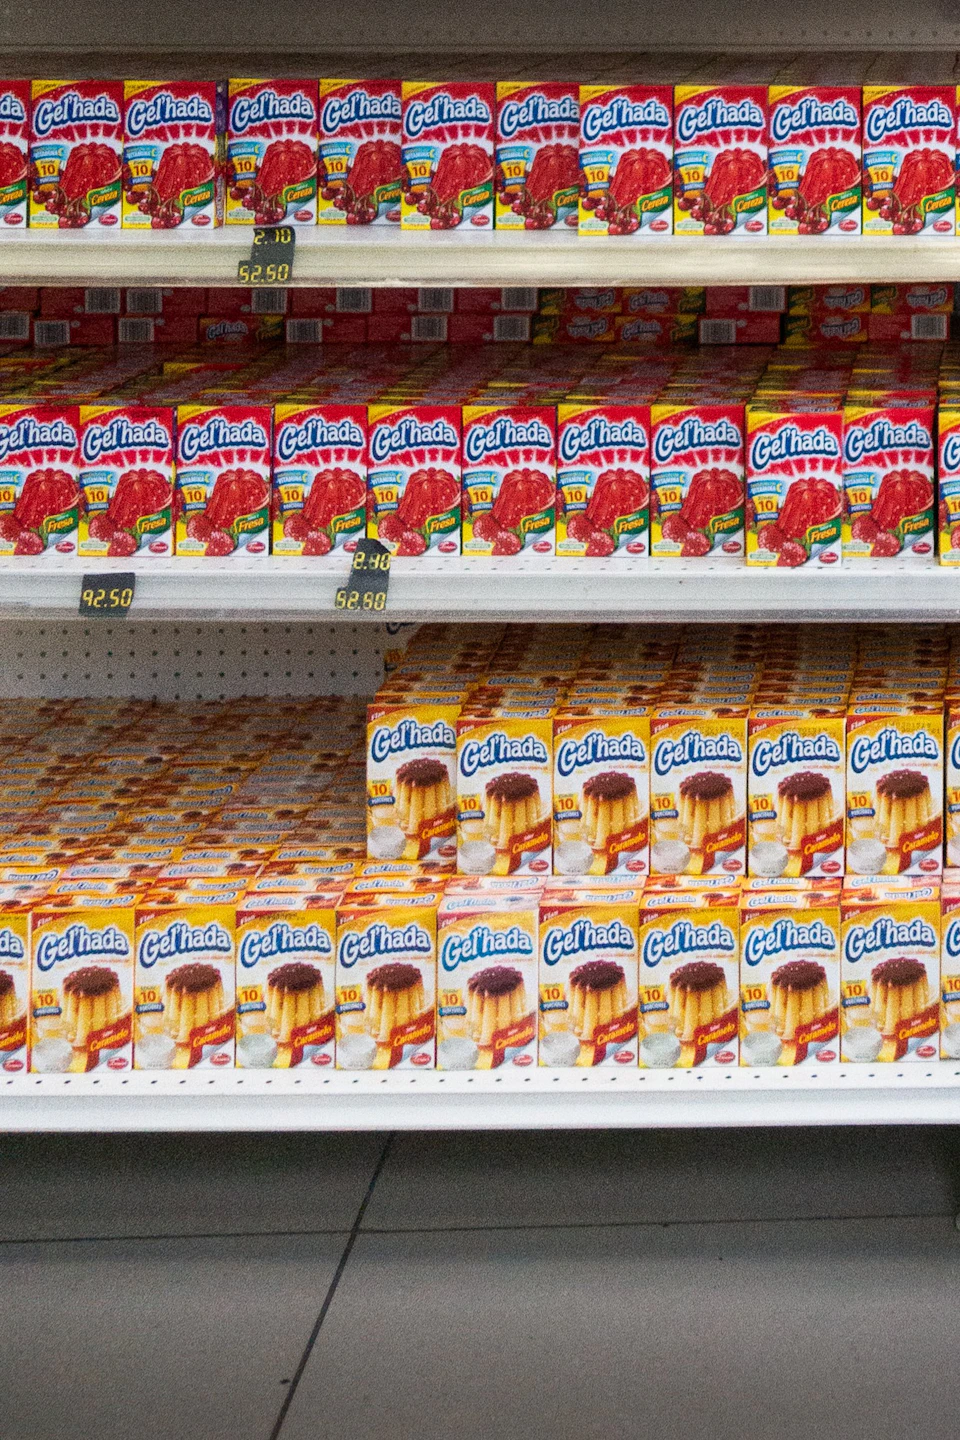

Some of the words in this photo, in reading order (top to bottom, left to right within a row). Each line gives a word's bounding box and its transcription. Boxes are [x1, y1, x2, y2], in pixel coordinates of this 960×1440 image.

[35, 95, 118, 136] Gel'hada
[232, 93, 312, 133] Gel'hada
[406, 96, 489, 137] Gel'hada
[679, 100, 762, 141] Gel'hada
[411, 165, 427, 176] 10
[873, 170, 889, 181] 10
[90, 190, 117, 206] Cereza
[736, 196, 763, 212] Cereza
[253, 228, 291, 245] 2.10
[238, 264, 289, 283] 52.50
[85, 420, 168, 461] Gel'hada
[280, 419, 363, 460] Gel'hada
[657, 420, 740, 461] Gel'hada
[472, 490, 488, 501] 10
[141, 517, 166, 532] Fresa
[714, 517, 739, 532] Fresa
[82, 589, 133, 608] 92.50
[460, 732, 547, 775] Gel'hada
[654, 731, 741, 774] Gel'hada
[851, 728, 938, 771] Gel'hada
[654, 798, 670, 810] 10
[37, 925, 130, 973] Gel'hada
[241, 923, 331, 969] Gel'hada
[544, 920, 634, 966] Gel'hada
[846, 918, 936, 964] Gel'hada
[846, 984, 862, 996] 10
